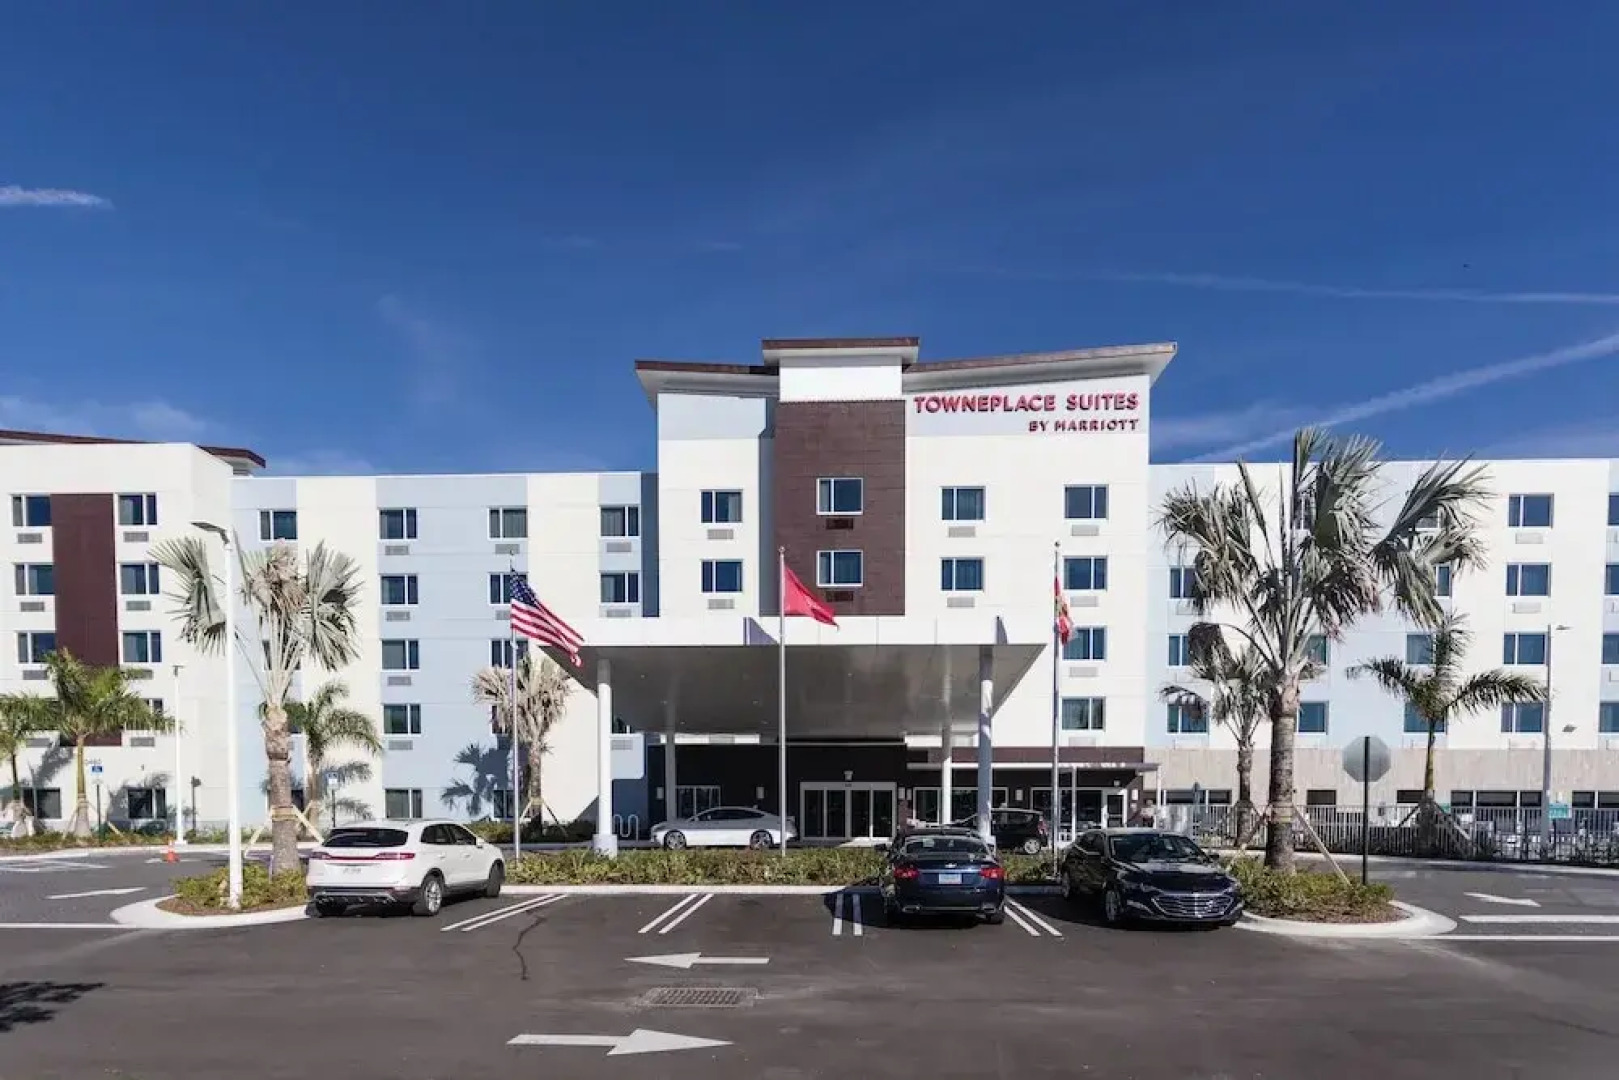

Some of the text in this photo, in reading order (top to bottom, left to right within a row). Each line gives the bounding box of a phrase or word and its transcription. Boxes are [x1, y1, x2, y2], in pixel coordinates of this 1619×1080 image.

[914, 392, 1139, 414] TOWNEPLACE SUITES
[1029, 419, 1139, 432] BY MARRIOTT
